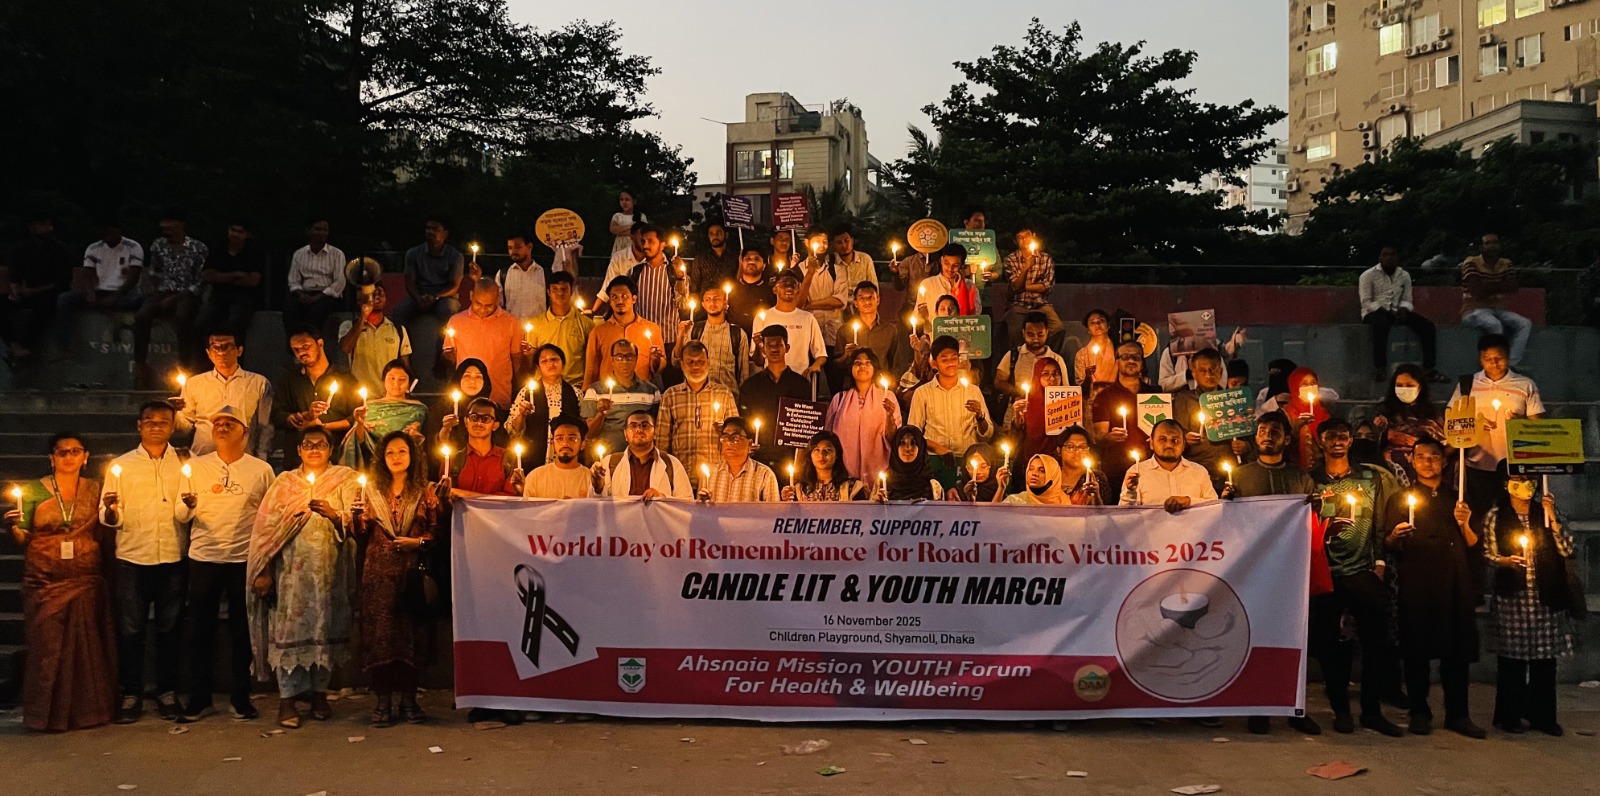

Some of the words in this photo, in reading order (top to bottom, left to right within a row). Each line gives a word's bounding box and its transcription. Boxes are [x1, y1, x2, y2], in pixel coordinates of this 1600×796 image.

[1047, 415, 1063, 426] Lose
[1070, 408, 1080, 419] Lot
[773, 517, 864, 537] REMEMBER,
[869, 519, 943, 538] SUPPORT,
[949, 520, 980, 537] ACT
[527, 534, 602, 557] World
[609, 536, 656, 563] Day
[660, 538, 686, 559] of
[689, 538, 867, 562] Remembrance
[878, 540, 913, 562] for
[918, 541, 980, 564] Road
[984, 542, 1064, 564] Traffic
[1069, 543, 1160, 566] Victims
[1165, 540, 1225, 563] 2025
[681, 571, 789, 602] CANDLE
[793, 573, 836, 602] LIT
[840, 573, 861, 604] &
[866, 574, 960, 605] YOUTH
[961, 575, 1067, 606] MARCH
[823, 615, 834, 626] 16
[837, 615, 893, 627] November
[896, 616, 921, 627] 2025
[769, 631, 815, 642] Children
[818, 632, 882, 645] Playground,
[884, 633, 938, 645] Shyamoli,
[940, 634, 975, 645] Dhaka
[677, 655, 770, 672] Ahsnaia
[776, 656, 863, 674] Mission
[872, 659, 953, 676] YOUTH
[958, 660, 1032, 677] Forum
[725, 676, 765, 693] For
[769, 677, 843, 694] Health
[848, 678, 866, 696] &
[874, 679, 985, 701] Wellbeing
